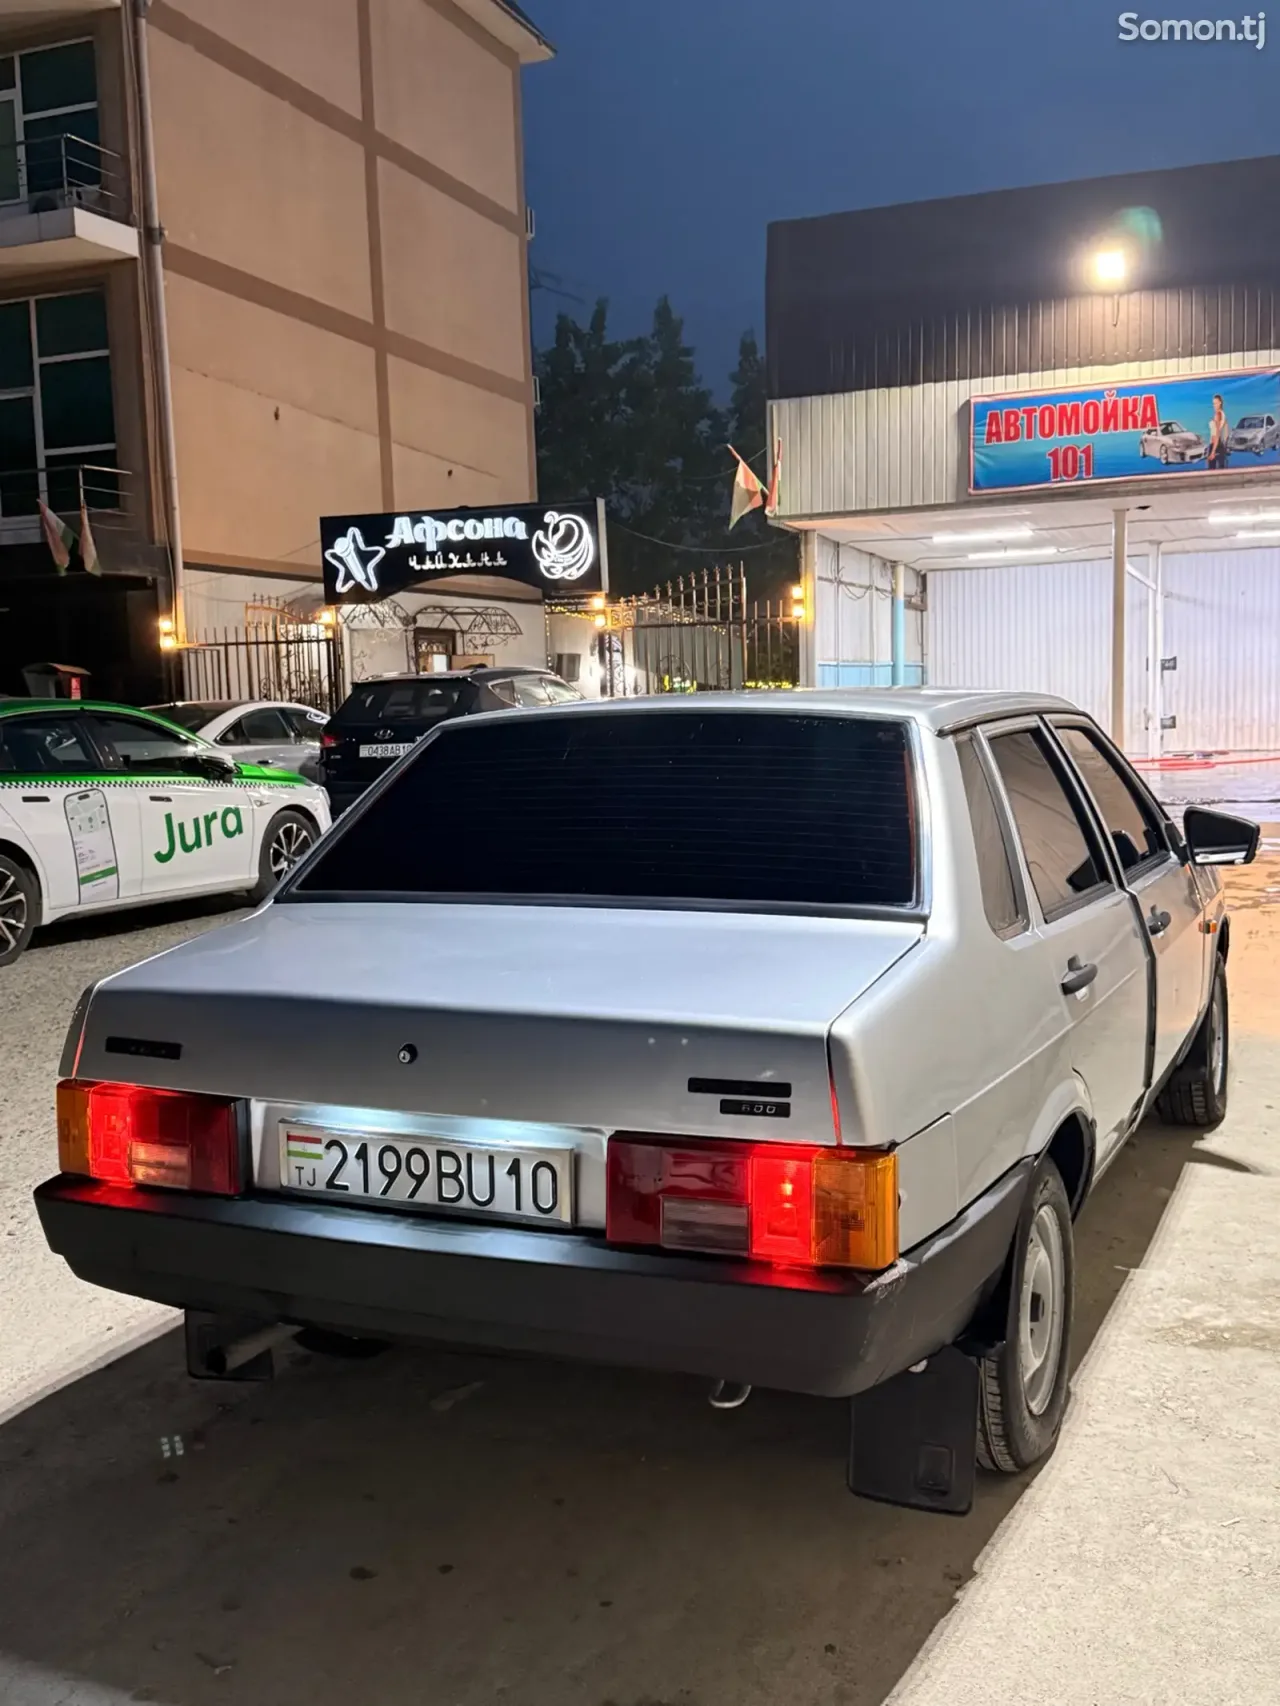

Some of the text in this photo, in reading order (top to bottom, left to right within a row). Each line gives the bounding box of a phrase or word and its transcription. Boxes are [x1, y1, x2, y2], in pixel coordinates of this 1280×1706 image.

[985, 390, 1159, 444] АВТОМОЙКА
[1046, 443, 1095, 481] 101
[385, 515, 529, 552] Афсона
[153, 806, 244, 864] Jura
[294, 1139, 558, 1215] TJ 2199BU10
